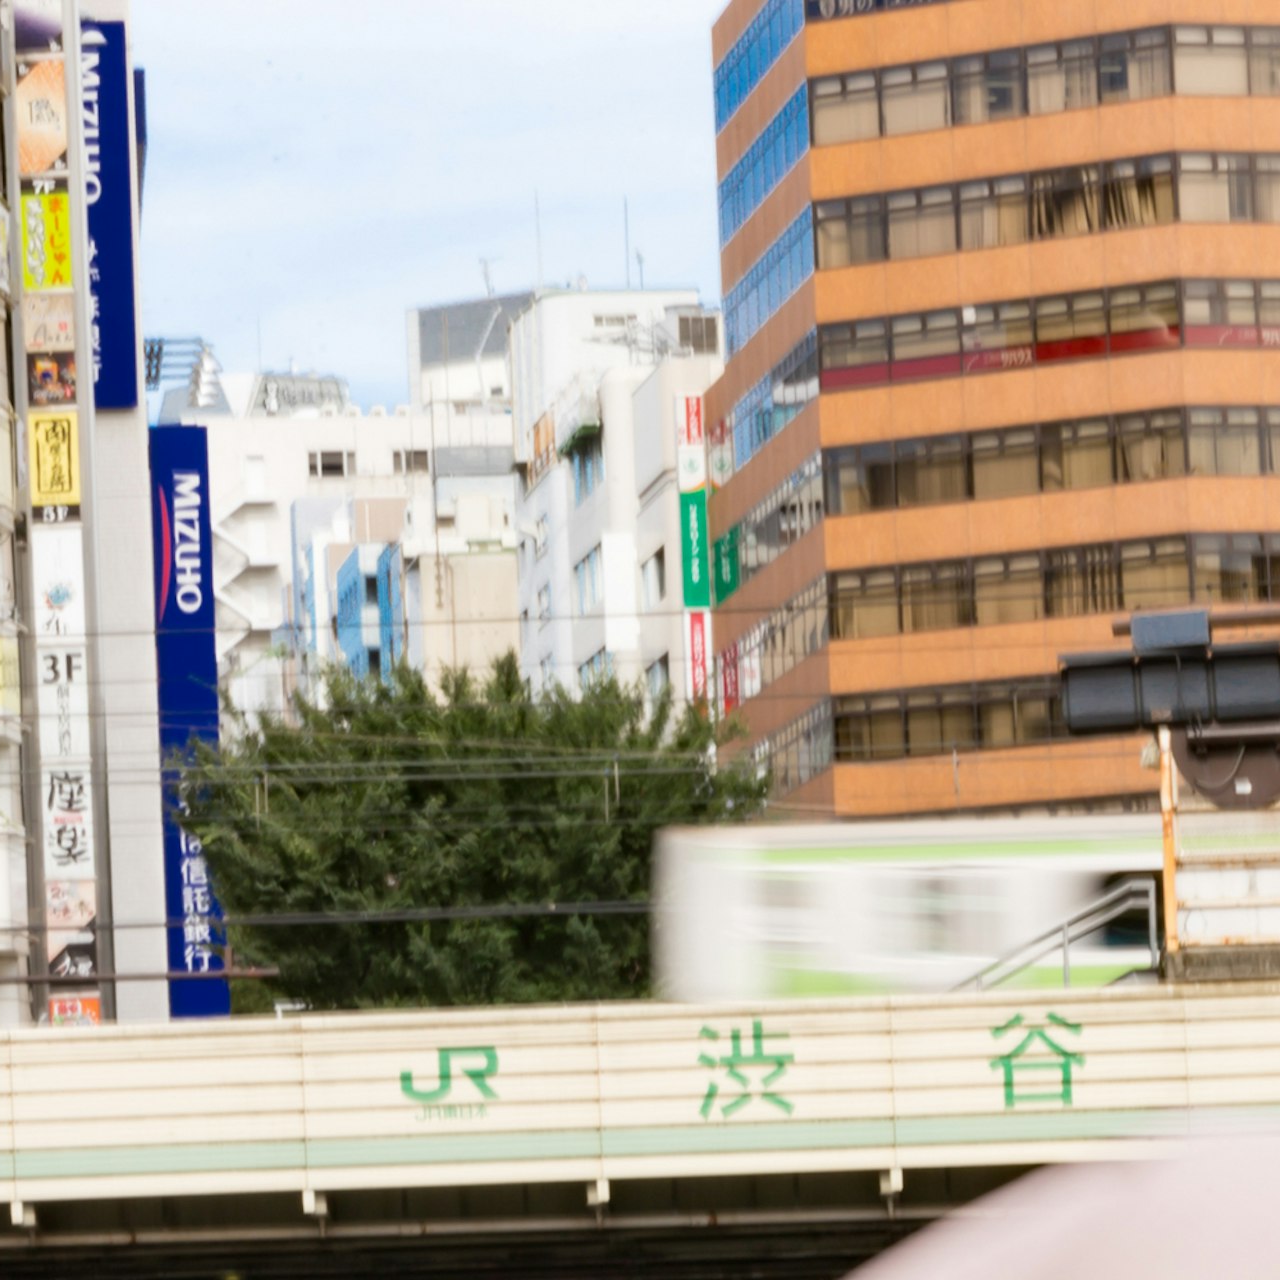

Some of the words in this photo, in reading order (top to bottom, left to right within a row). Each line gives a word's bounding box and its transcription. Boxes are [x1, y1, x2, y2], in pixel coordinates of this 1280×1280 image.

[173, 471, 203, 614] MIZUHO
[43, 653, 83, 685] 3F
[400, 1046, 499, 1103] JR
